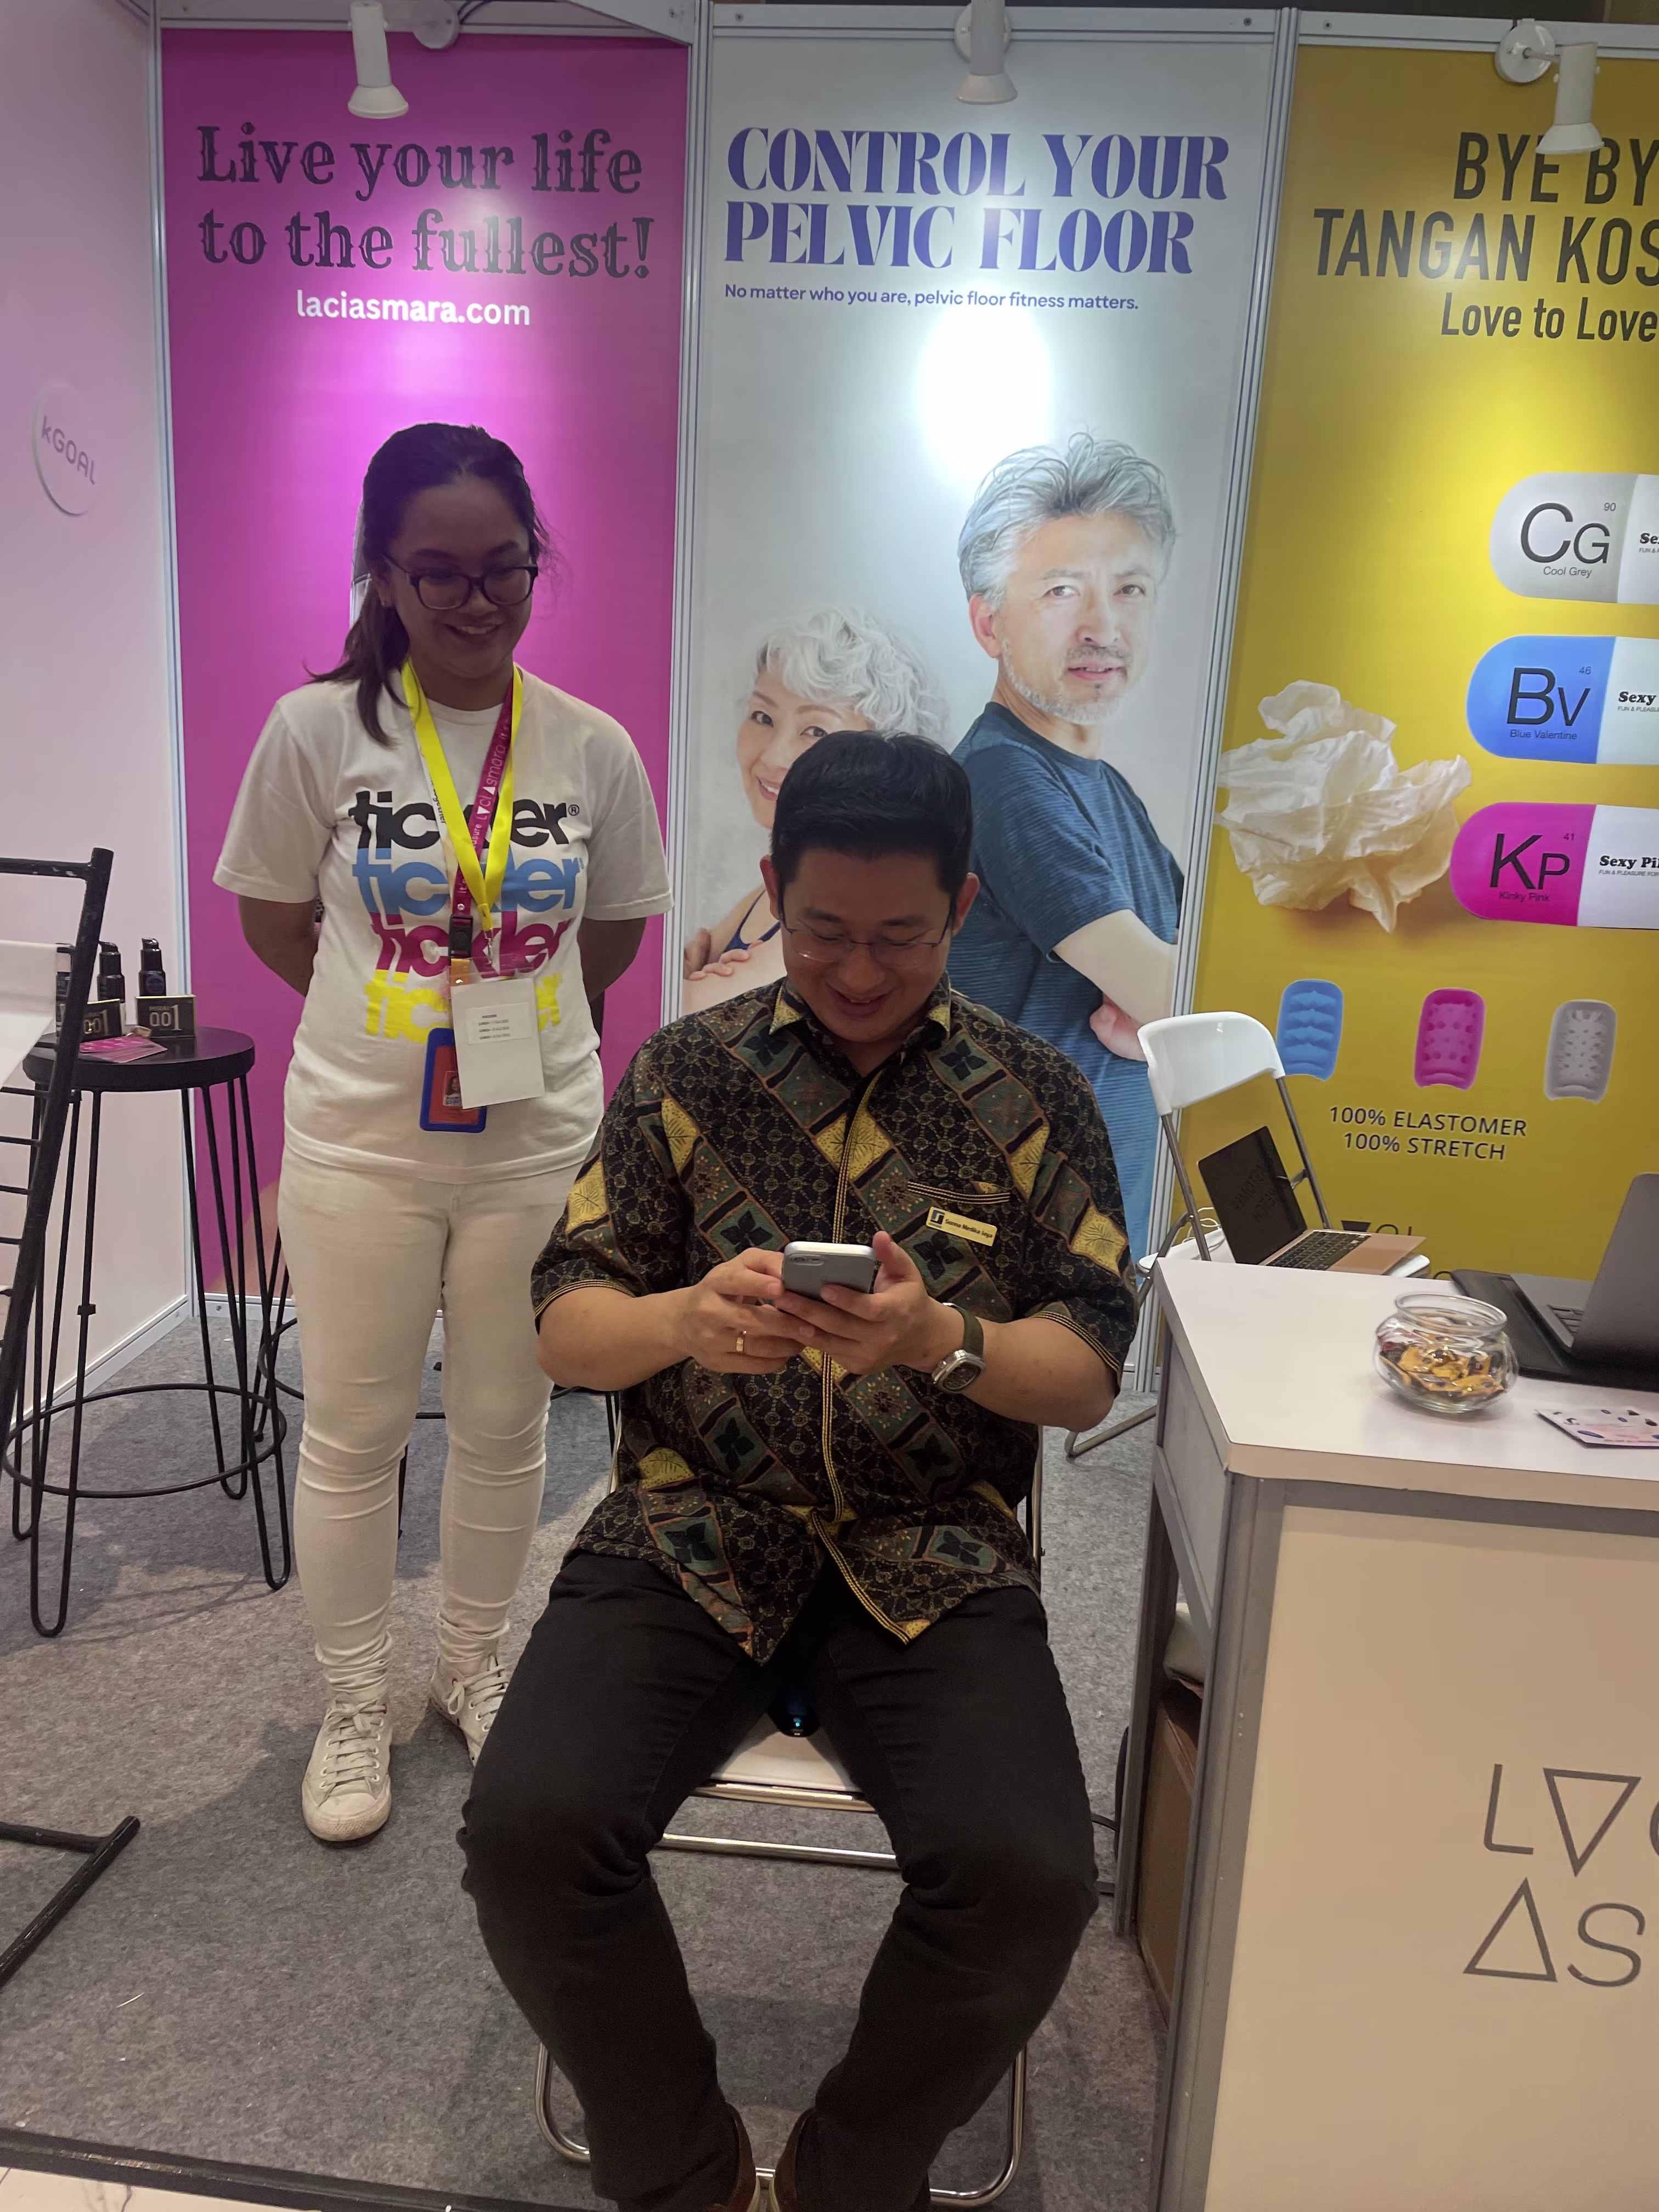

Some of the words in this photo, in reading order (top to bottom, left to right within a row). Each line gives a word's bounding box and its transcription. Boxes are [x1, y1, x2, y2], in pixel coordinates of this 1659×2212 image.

[196, 121, 335, 185] Live
[350, 139, 514, 201] your
[531, 128, 642, 194] life
[727, 127, 1025, 196] CONTROL
[1042, 134, 1229, 200] YOUR
[1453, 132, 1560, 203] BYE
[199, 207, 267, 265] to
[285, 210, 394, 269] the
[411, 208, 654, 279] fullest!
[723, 200, 955, 269] PELVIC
[978, 207, 1194, 274] FLOOR
[1313, 208, 1535, 281] TANGAN
[297, 289, 531, 326] laciasmara.com
[725, 284, 747, 298] No
[750, 286, 806, 301] matter
[809, 287, 844, 301] who
[847, 290, 877, 305] you
[881, 292, 911, 306] are,
[914, 290, 963, 307] pelvic
[967, 290, 1006, 306] floor
[1009, 291, 1065, 308] fitness
[1068, 295, 1139, 309] matters.
[1441, 292, 1522, 337] Love
[1533, 298, 1565, 338] to
[1577, 297, 1658, 342] Love
[1604, 502, 1616, 511] 90
[1543, 566, 1566, 575] Cool
[1569, 567, 1592, 578] Grey
[1579, 666, 1592, 675] 46
[1618, 691, 1657, 706] Sexy
[1510, 729, 1531, 738] Blue
[1535, 730, 1577, 740] Valentine
[1563, 832, 1575, 840] 41
[1600, 855, 1637, 870] Sexy
[1329, 1107, 1386, 1126] 100%
[1393, 1111, 1527, 1136] ELASTOMER
[1344, 1132, 1400, 1152] 100%
[1407, 1137, 1505, 1160] STRETCH
